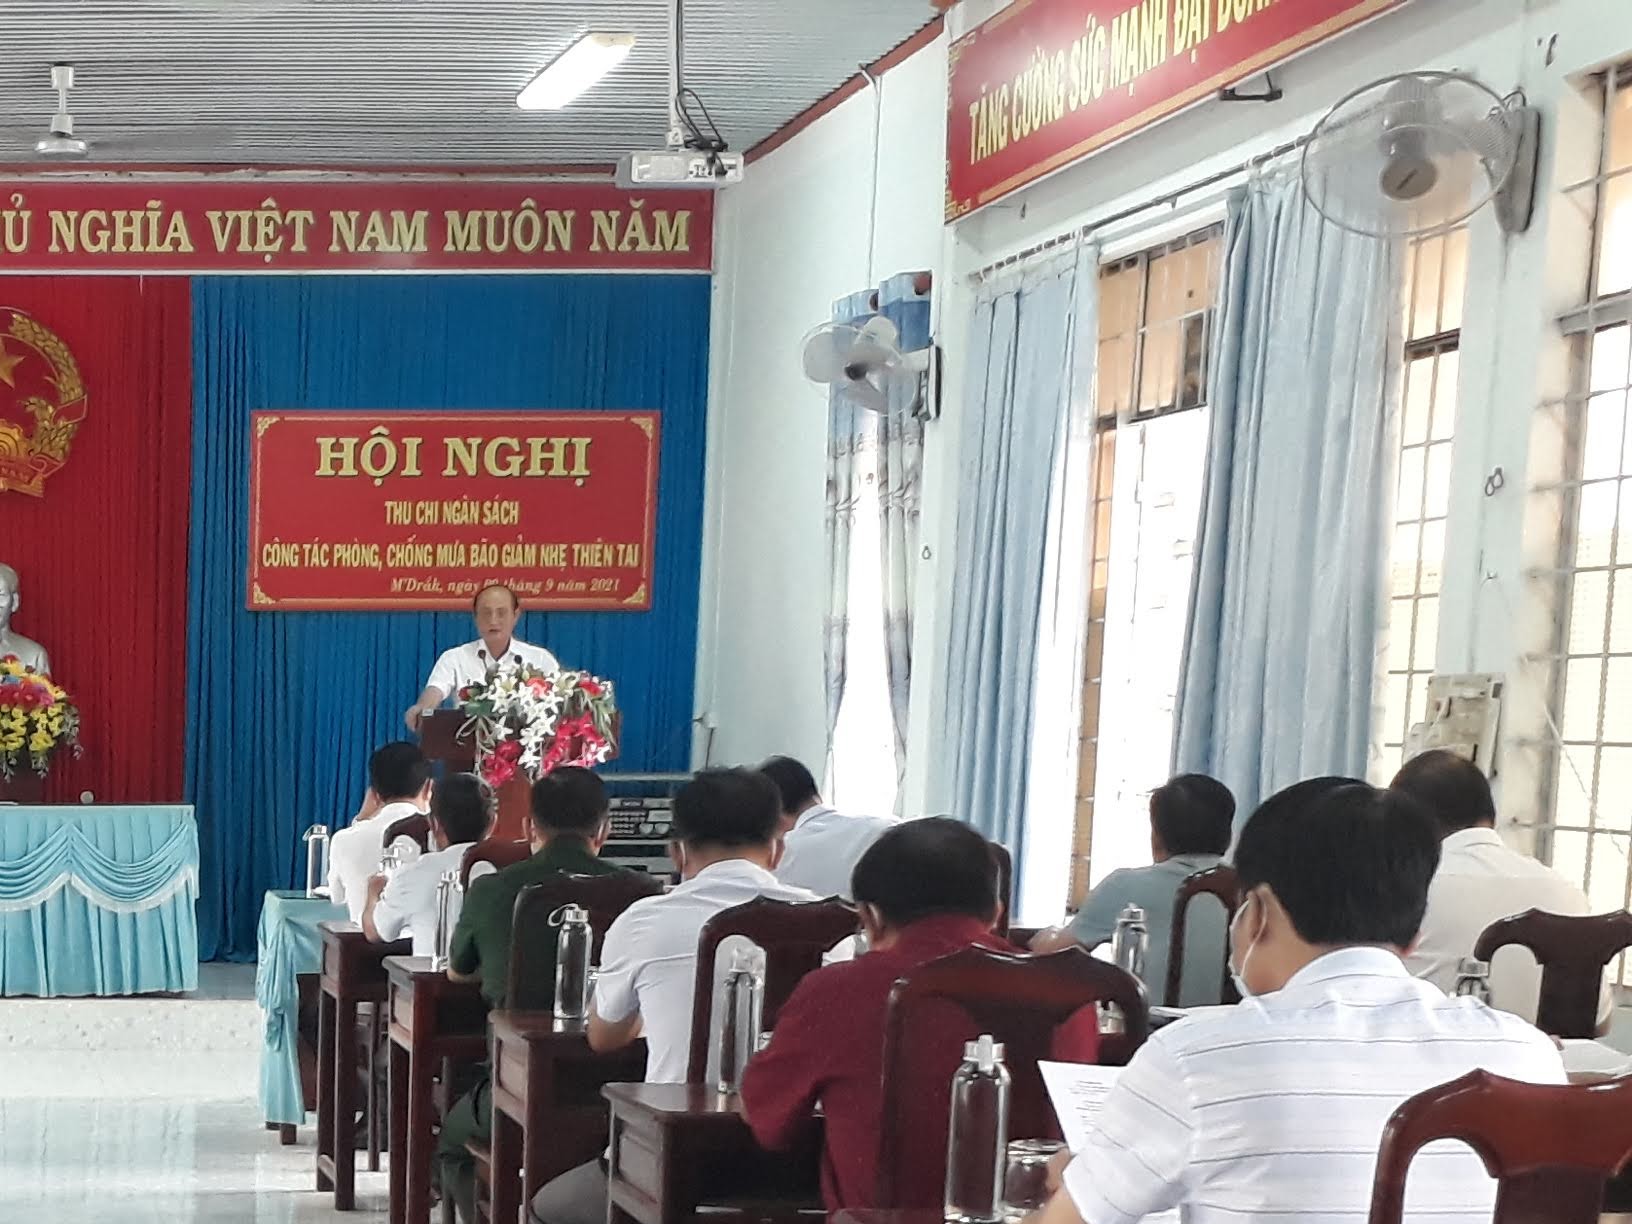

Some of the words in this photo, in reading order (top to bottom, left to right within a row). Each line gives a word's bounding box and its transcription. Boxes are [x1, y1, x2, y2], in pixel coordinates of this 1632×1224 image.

[969, 82, 1009, 165] TĂNG
[1068, 13, 1106, 112] SỨC
[1109, 0, 1167, 96] MẠNH
[48, 199, 194, 254] NGHĨA
[205, 197, 314, 263] VIỆT
[328, 210, 429, 252] NAM
[444, 197, 576, 253] MUÔN
[589, 198, 691, 252] NĂM
[314, 425, 423, 487] HỘI
[441, 436, 592, 487] NGHỊ
[384, 500, 412, 526] THU
[415, 500, 439, 526] CHI
[442, 495, 480, 526] NGÂN
[482, 494, 519, 526] SÁCH
[262, 536, 300, 568] CÔNG
[302, 536, 330, 568] TÁC
[386, 534, 433, 568] CHỐNG
[470, 537, 499, 568] BÃO
[501, 533, 537, 568] GIẢM
[539, 543, 568, 573] NHẸ
[572, 537, 613, 568] THIÊN
[616, 543, 640, 568] TAI
[544, 578, 555, 592] 9
[589, 577, 620, 592] 2021
